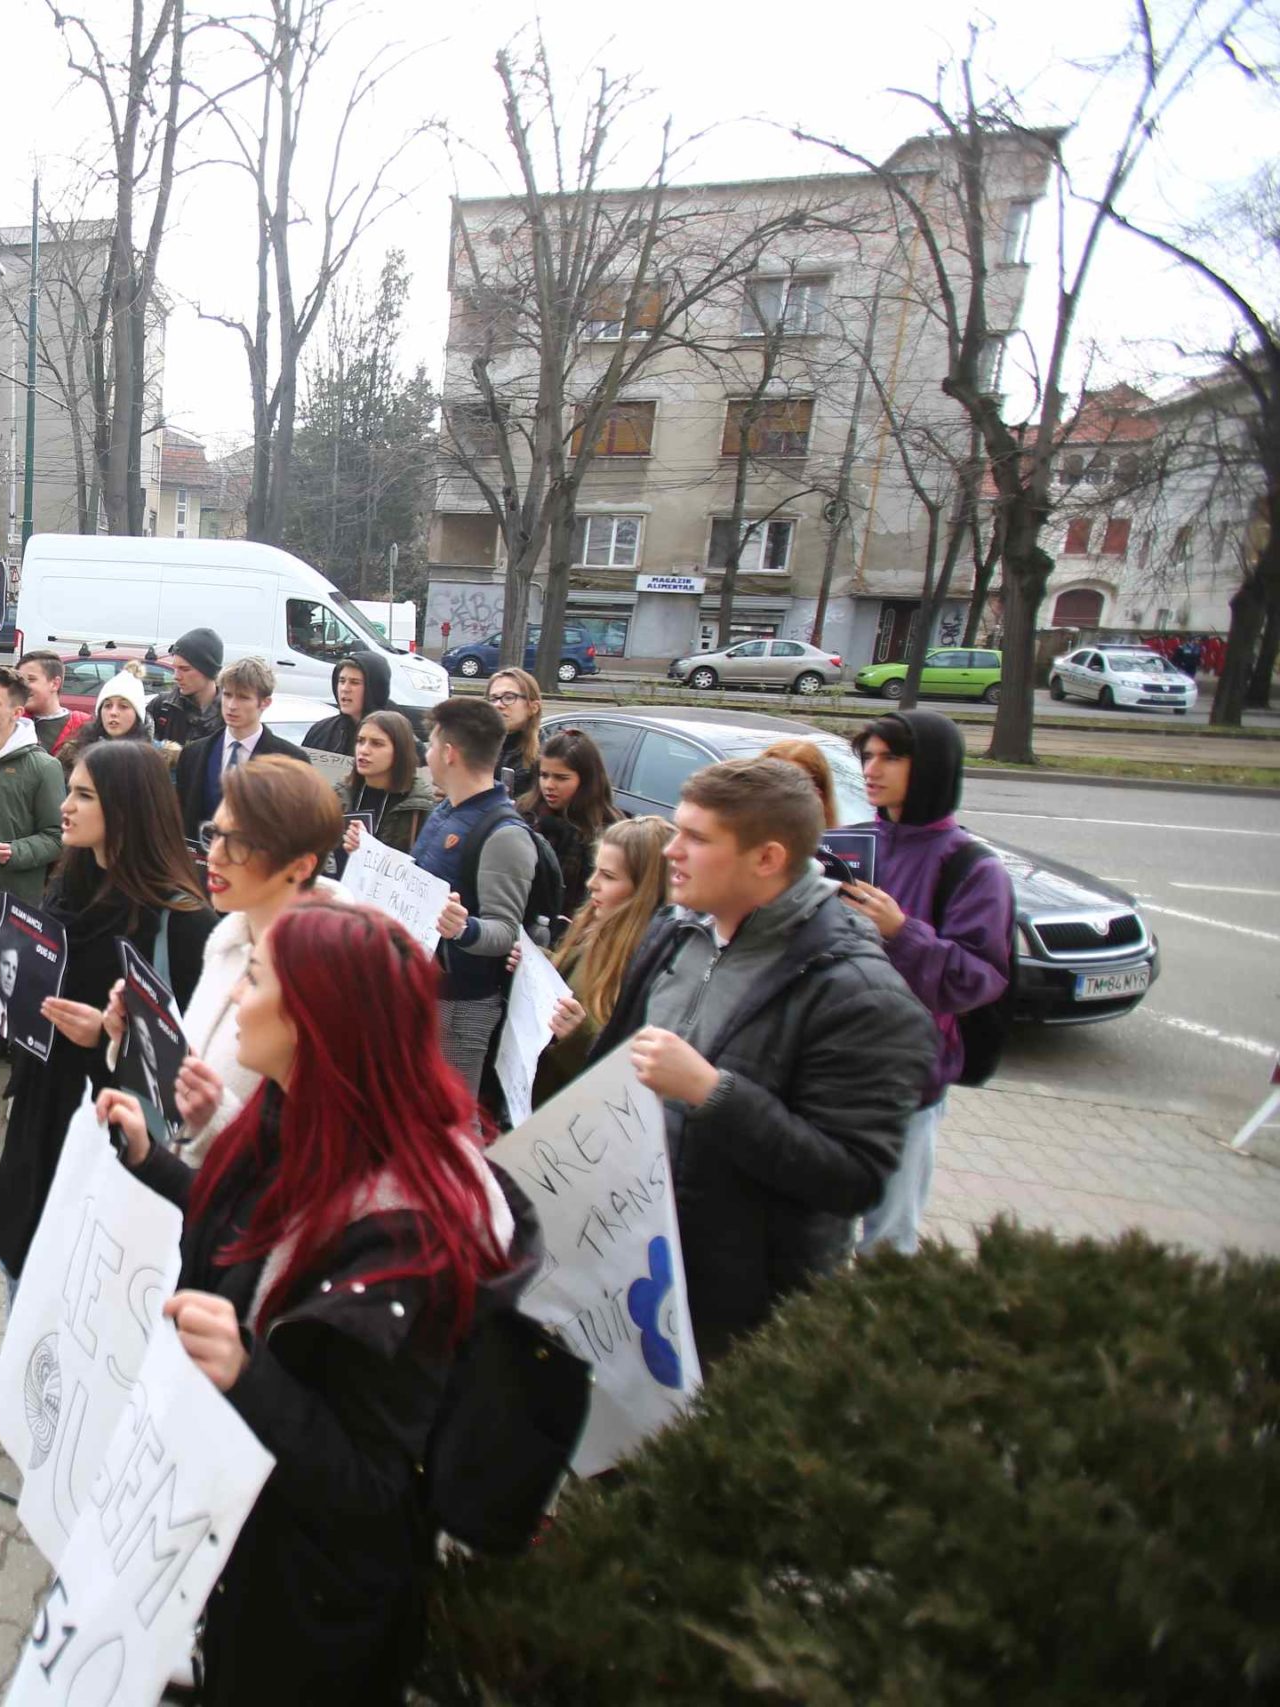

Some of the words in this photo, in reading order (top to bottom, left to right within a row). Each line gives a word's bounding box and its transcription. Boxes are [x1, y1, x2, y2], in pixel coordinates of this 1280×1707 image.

[11, 904, 27, 922] IULIAN
[27, 913, 43, 933] IANCU,
[36, 943, 48, 957] OUG
[48, 950, 58, 963] 51!
[1086, 977, 1104, 994] TM
[1106, 975, 1122, 992] 84
[518, 1084, 647, 1196] VREM
